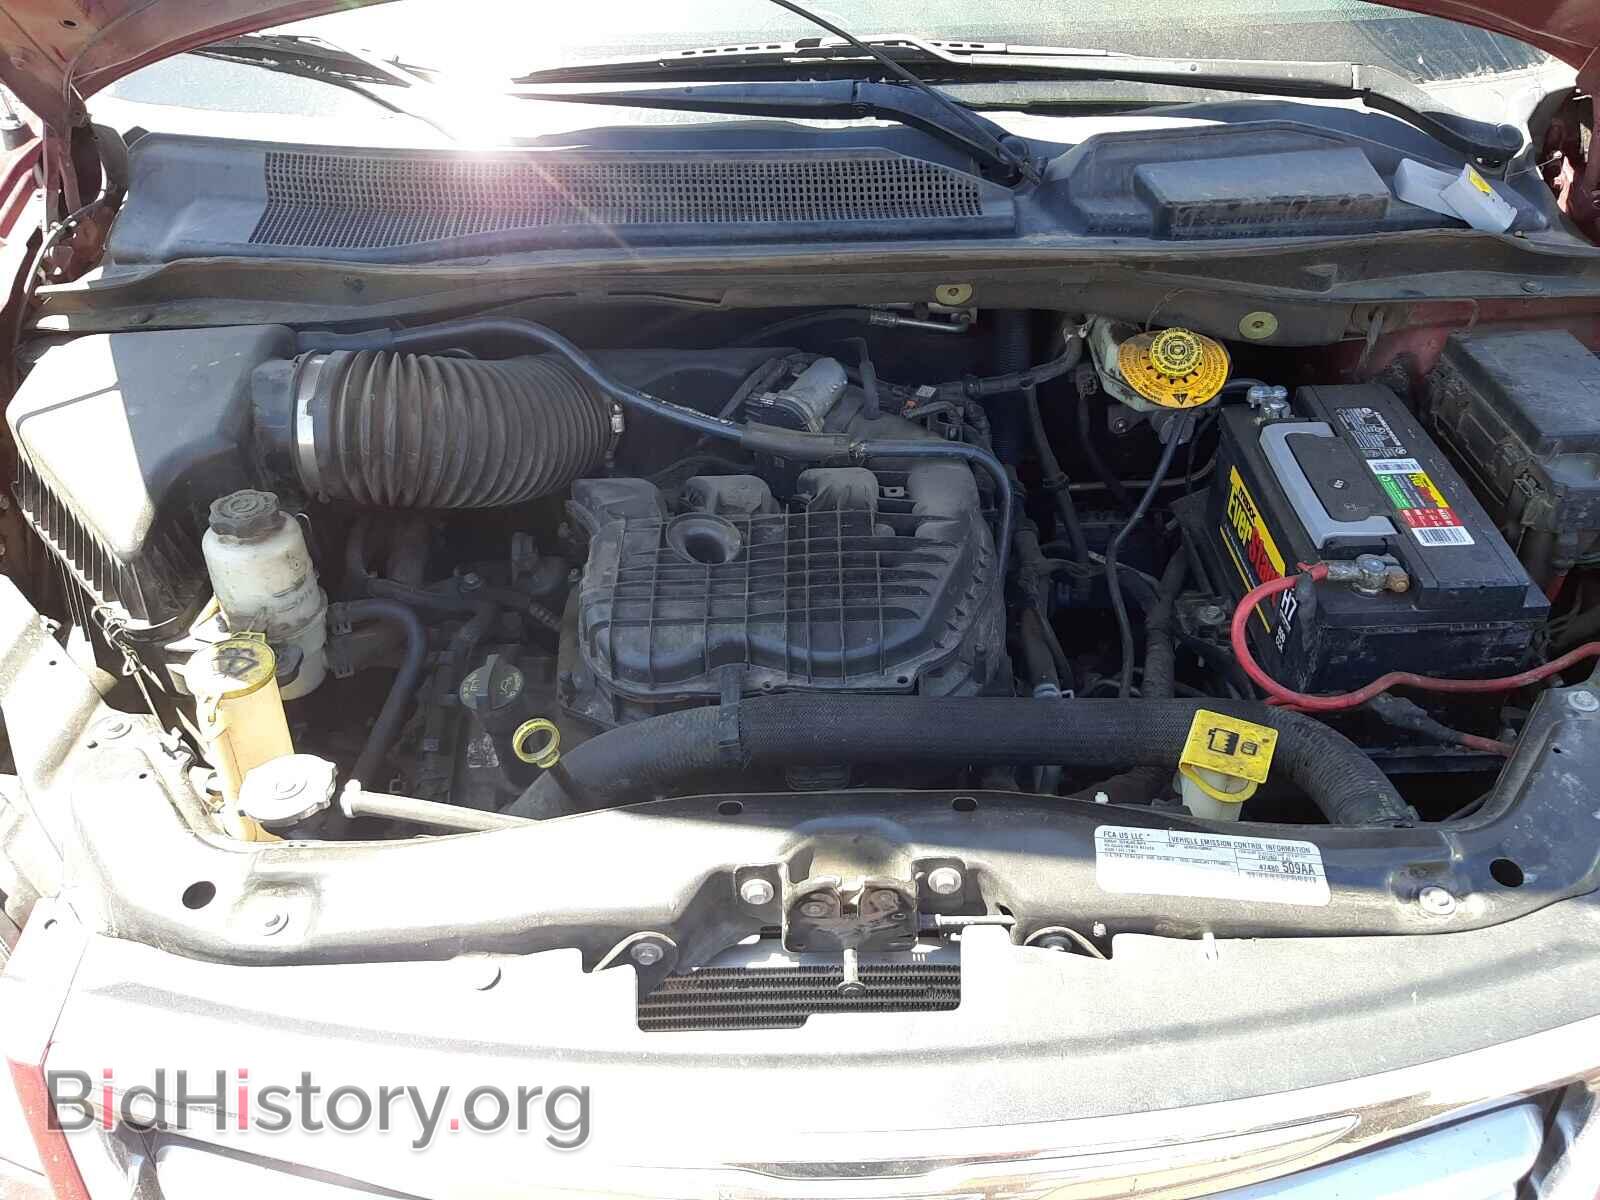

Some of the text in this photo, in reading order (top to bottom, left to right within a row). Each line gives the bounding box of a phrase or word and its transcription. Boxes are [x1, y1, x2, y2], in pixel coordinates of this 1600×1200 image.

[1281, 588, 1297, 622] H7
[1103, 830, 1117, 838] FCA
[1119, 831, 1129, 839] US
[1171, 836, 1311, 853] VEHICLE EMISSION CONTROL INFORMATION
[1281, 861, 1316, 875] 509AA
